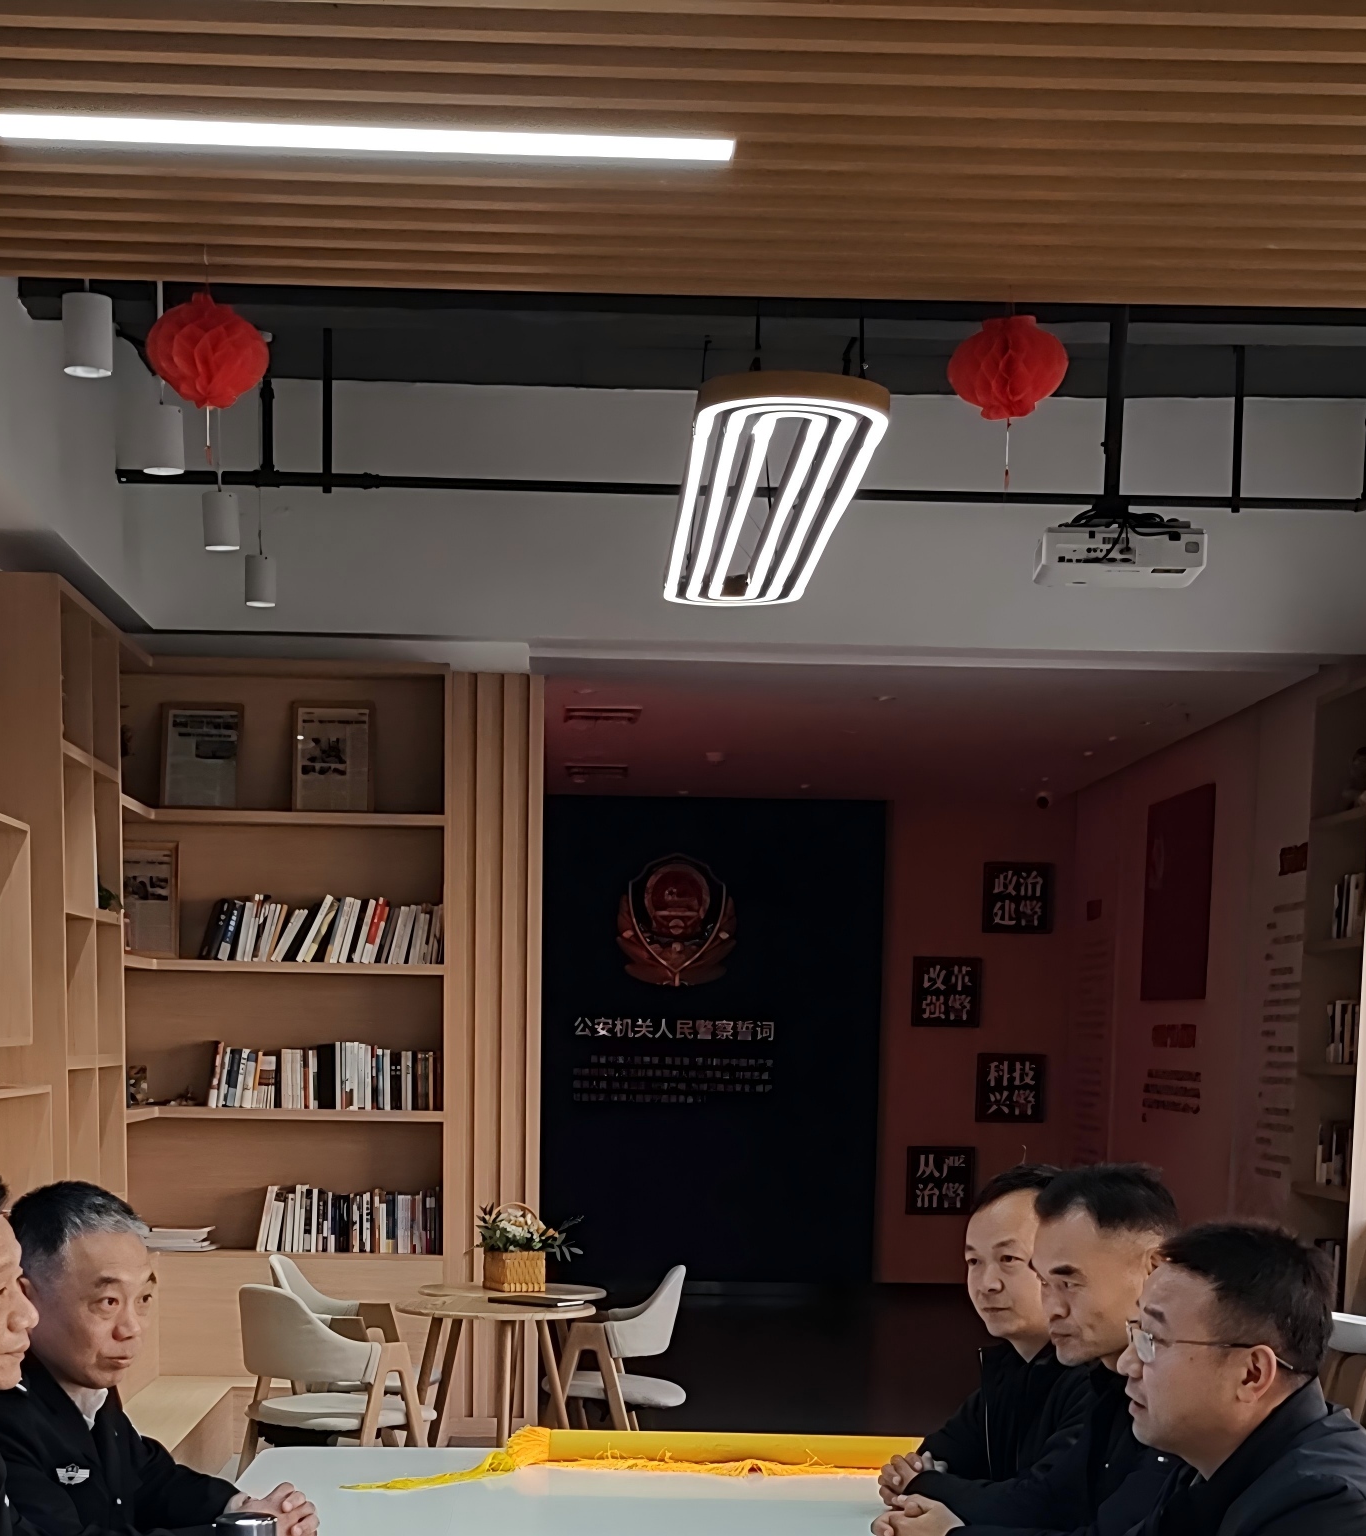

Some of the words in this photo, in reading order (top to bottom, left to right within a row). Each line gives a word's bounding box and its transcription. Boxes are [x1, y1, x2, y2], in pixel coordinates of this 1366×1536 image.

[992, 870, 1043, 897] 政治
[992, 899, 1043, 927] 建警
[921, 964, 973, 992] 改革
[921, 994, 972, 1021] 强警
[573, 1017, 776, 1042] 公安机关人民警察誓词
[986, 1060, 1036, 1087] 科技
[985, 1089, 1036, 1116] 兴警
[916, 1153, 966, 1180] 从严
[915, 1182, 965, 1209] 治警
